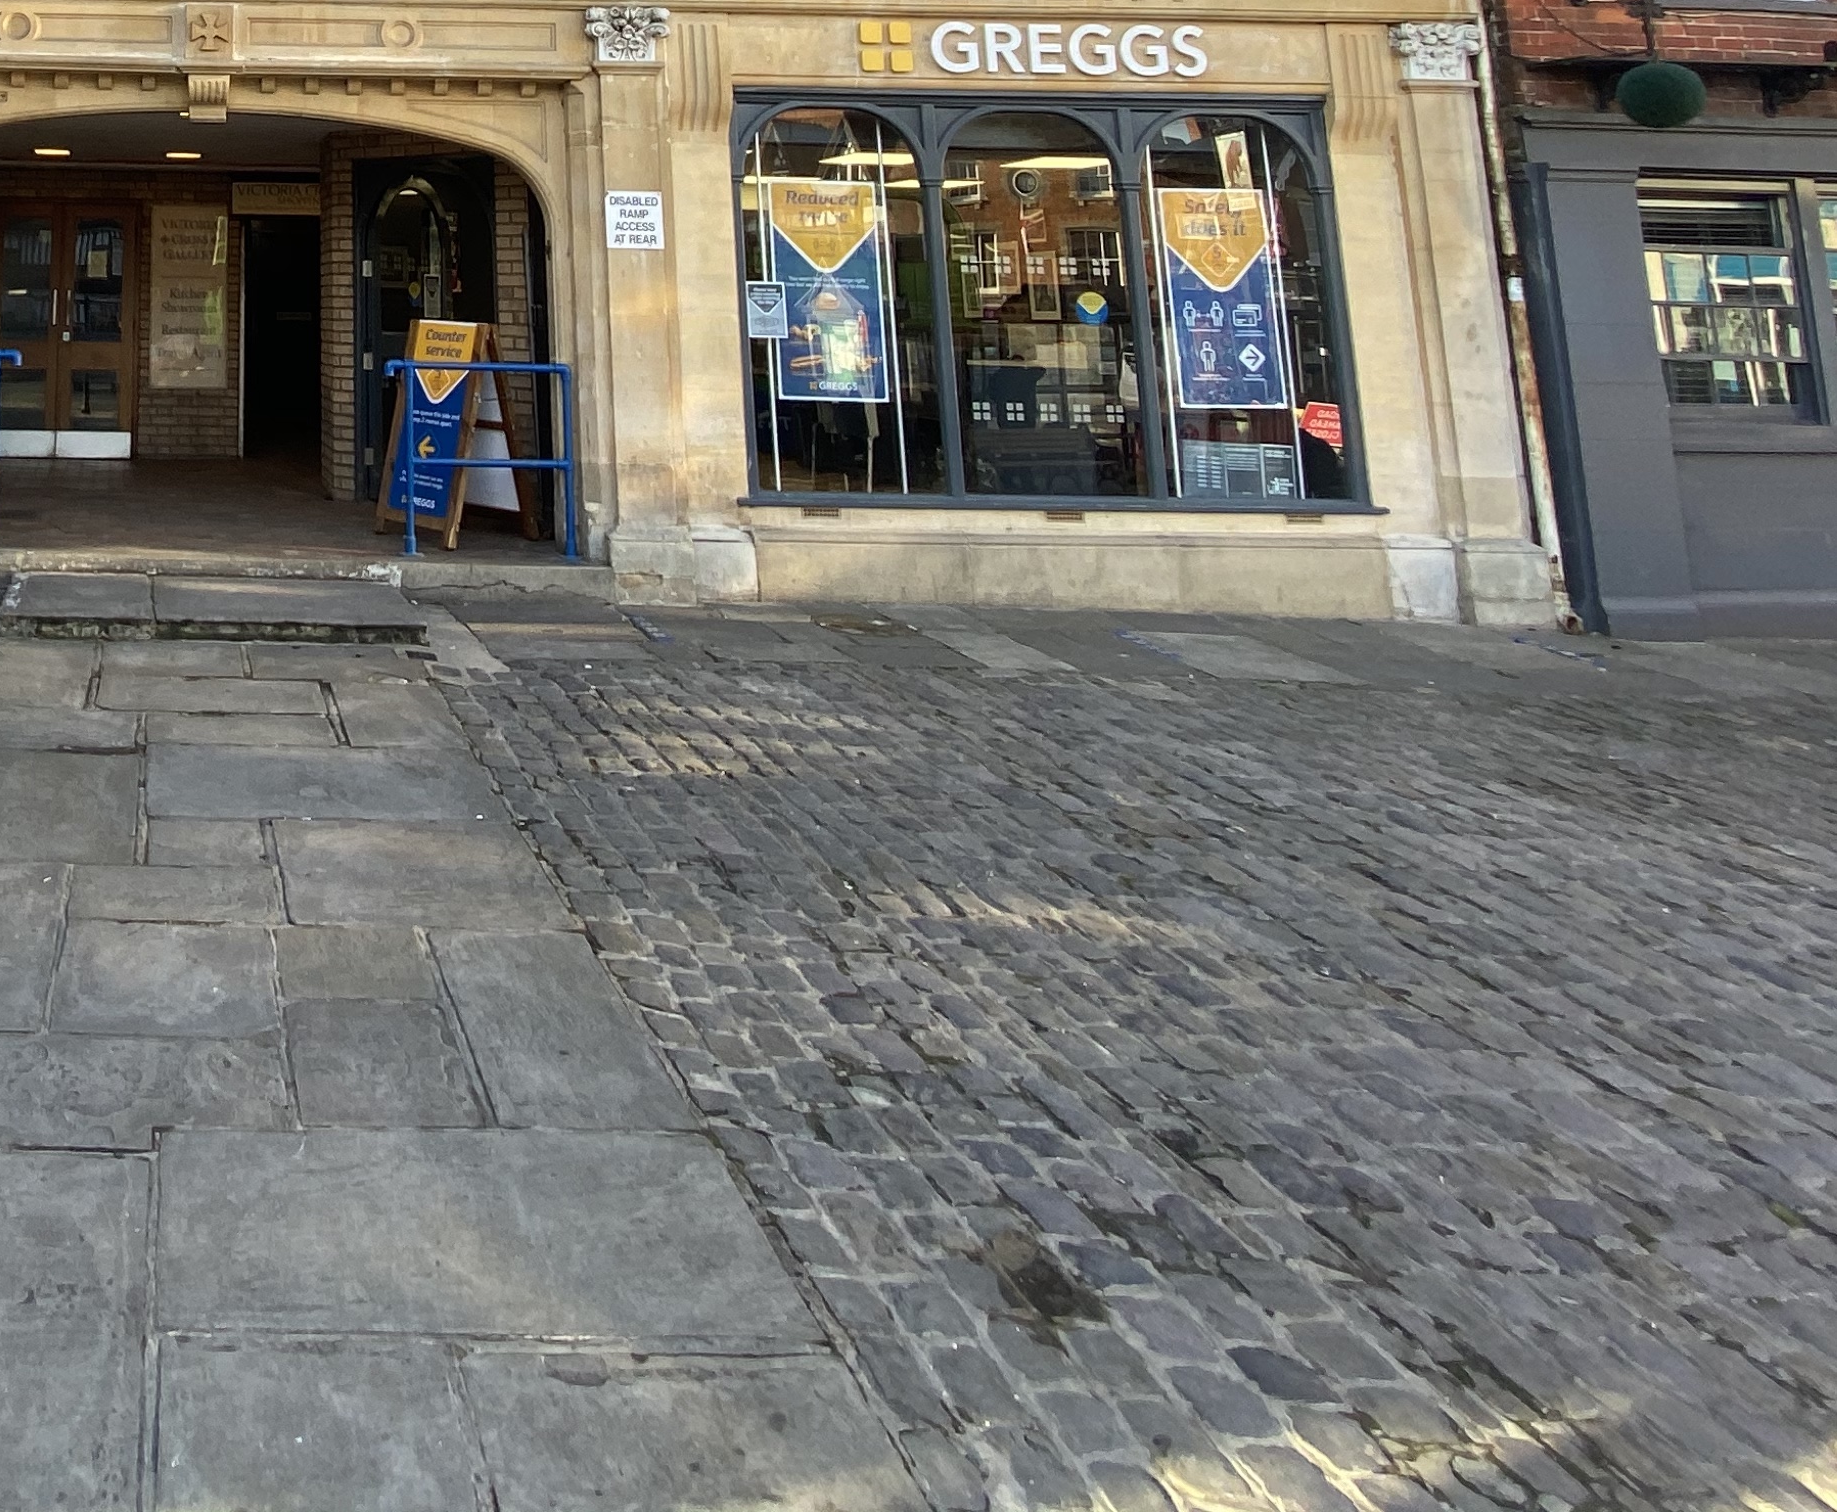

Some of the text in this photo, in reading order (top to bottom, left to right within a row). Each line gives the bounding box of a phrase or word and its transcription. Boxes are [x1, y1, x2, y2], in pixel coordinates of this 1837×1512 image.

[930, 20, 1209, 78] GREGGS
[609, 195, 659, 207] DISABLED
[785, 189, 860, 206] Reduced
[619, 208, 649, 219] RAMP
[614, 221, 656, 232] ACCESS
[1233, 221, 1247, 236] it
[614, 234, 658, 245] AT REAR
[425, 328, 467, 343] Counter
[425, 344, 462, 359] service
